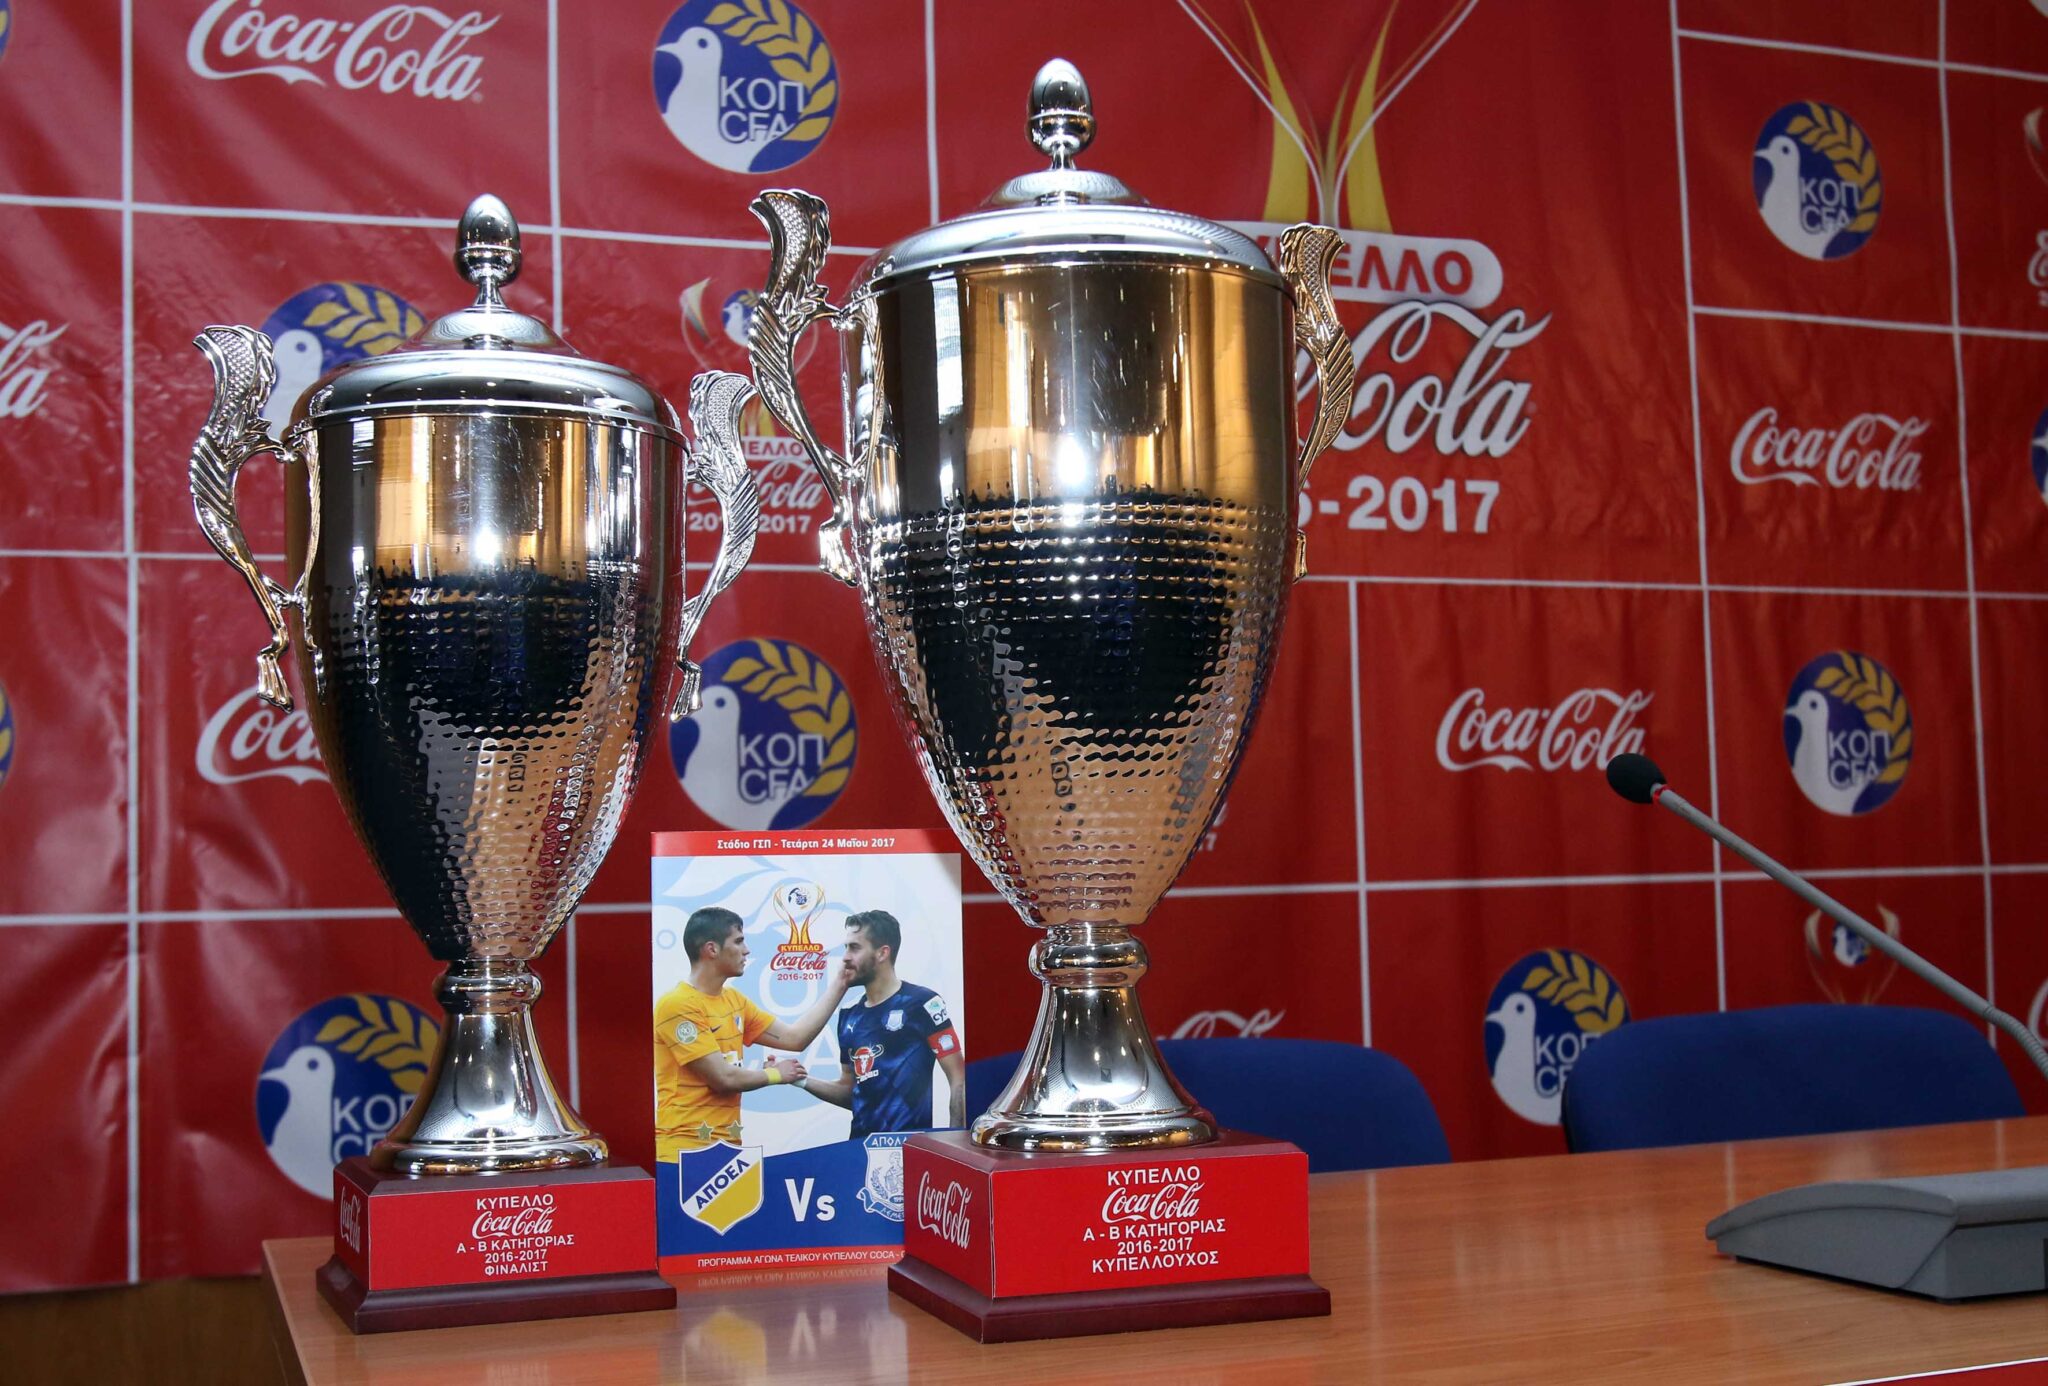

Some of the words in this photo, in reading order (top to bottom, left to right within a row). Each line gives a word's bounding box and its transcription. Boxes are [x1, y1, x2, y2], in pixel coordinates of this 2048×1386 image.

[186, 0, 500, 101] Coca-Cola
[720, 76, 806, 113] ΚΟΠ
[720, 111, 797, 143] CFA
[1800, 177, 1861, 208] ΚΟΠ
[1801, 205, 1851, 234] CFA
[1730, 406, 1932, 491] Coca-Cola
[739, 732, 826, 768] ΚΟΠ
[1829, 729, 1891, 760] ΚΟΠ
[739, 767, 815, 803] CFA
[1829, 757, 1882, 789] CFA
[717, 839, 750, 849] Στάδιο
[753, 839, 771, 849] ΓΣΠ
[822, 838, 834, 848] 24
[871, 837, 895, 848] 2017
[770, 950, 830, 971] Coca-Cola
[777, 972, 824, 981] 2016-2017
[1107, 1165, 1201, 1186] ΚΥΠΕΛΛΟ
[476, 1193, 555, 1211] ΚΥΠΕΛΛΟ
[784, 1177, 836, 1222] Vs
[917, 1170, 973, 1250] Coca-Cola
[1101, 1182, 1206, 1224] Coca-Cola
[471, 1206, 558, 1240] Coca-Cola
[1125, 1218, 1227, 1239] ΚΑΤΗΓΟΡΙΑΣ
[485, 1249, 548, 1264] 2016-2017
[491, 1234, 575, 1251] ΚΑΤΗΓΟΡΙΑΣ
[1117, 1236, 1194, 1256] 2016-2017
[484, 1261, 548, 1277] ΦΙΝΑΛΙΣΤ
[697, 1255, 753, 1268] ΠΡΟΓΡΑΜΜΑ
[753, 1253, 783, 1264] ΑΓΩΝΑ
[785, 1251, 821, 1263] ΤΕΛΙΚΟΥ
[822, 1249, 868, 1261] ΚΥΠΕΛΛΟΥ
[1092, 1250, 1220, 1274] ΚΥΠΕΛΛΟΥΧΟΣ
